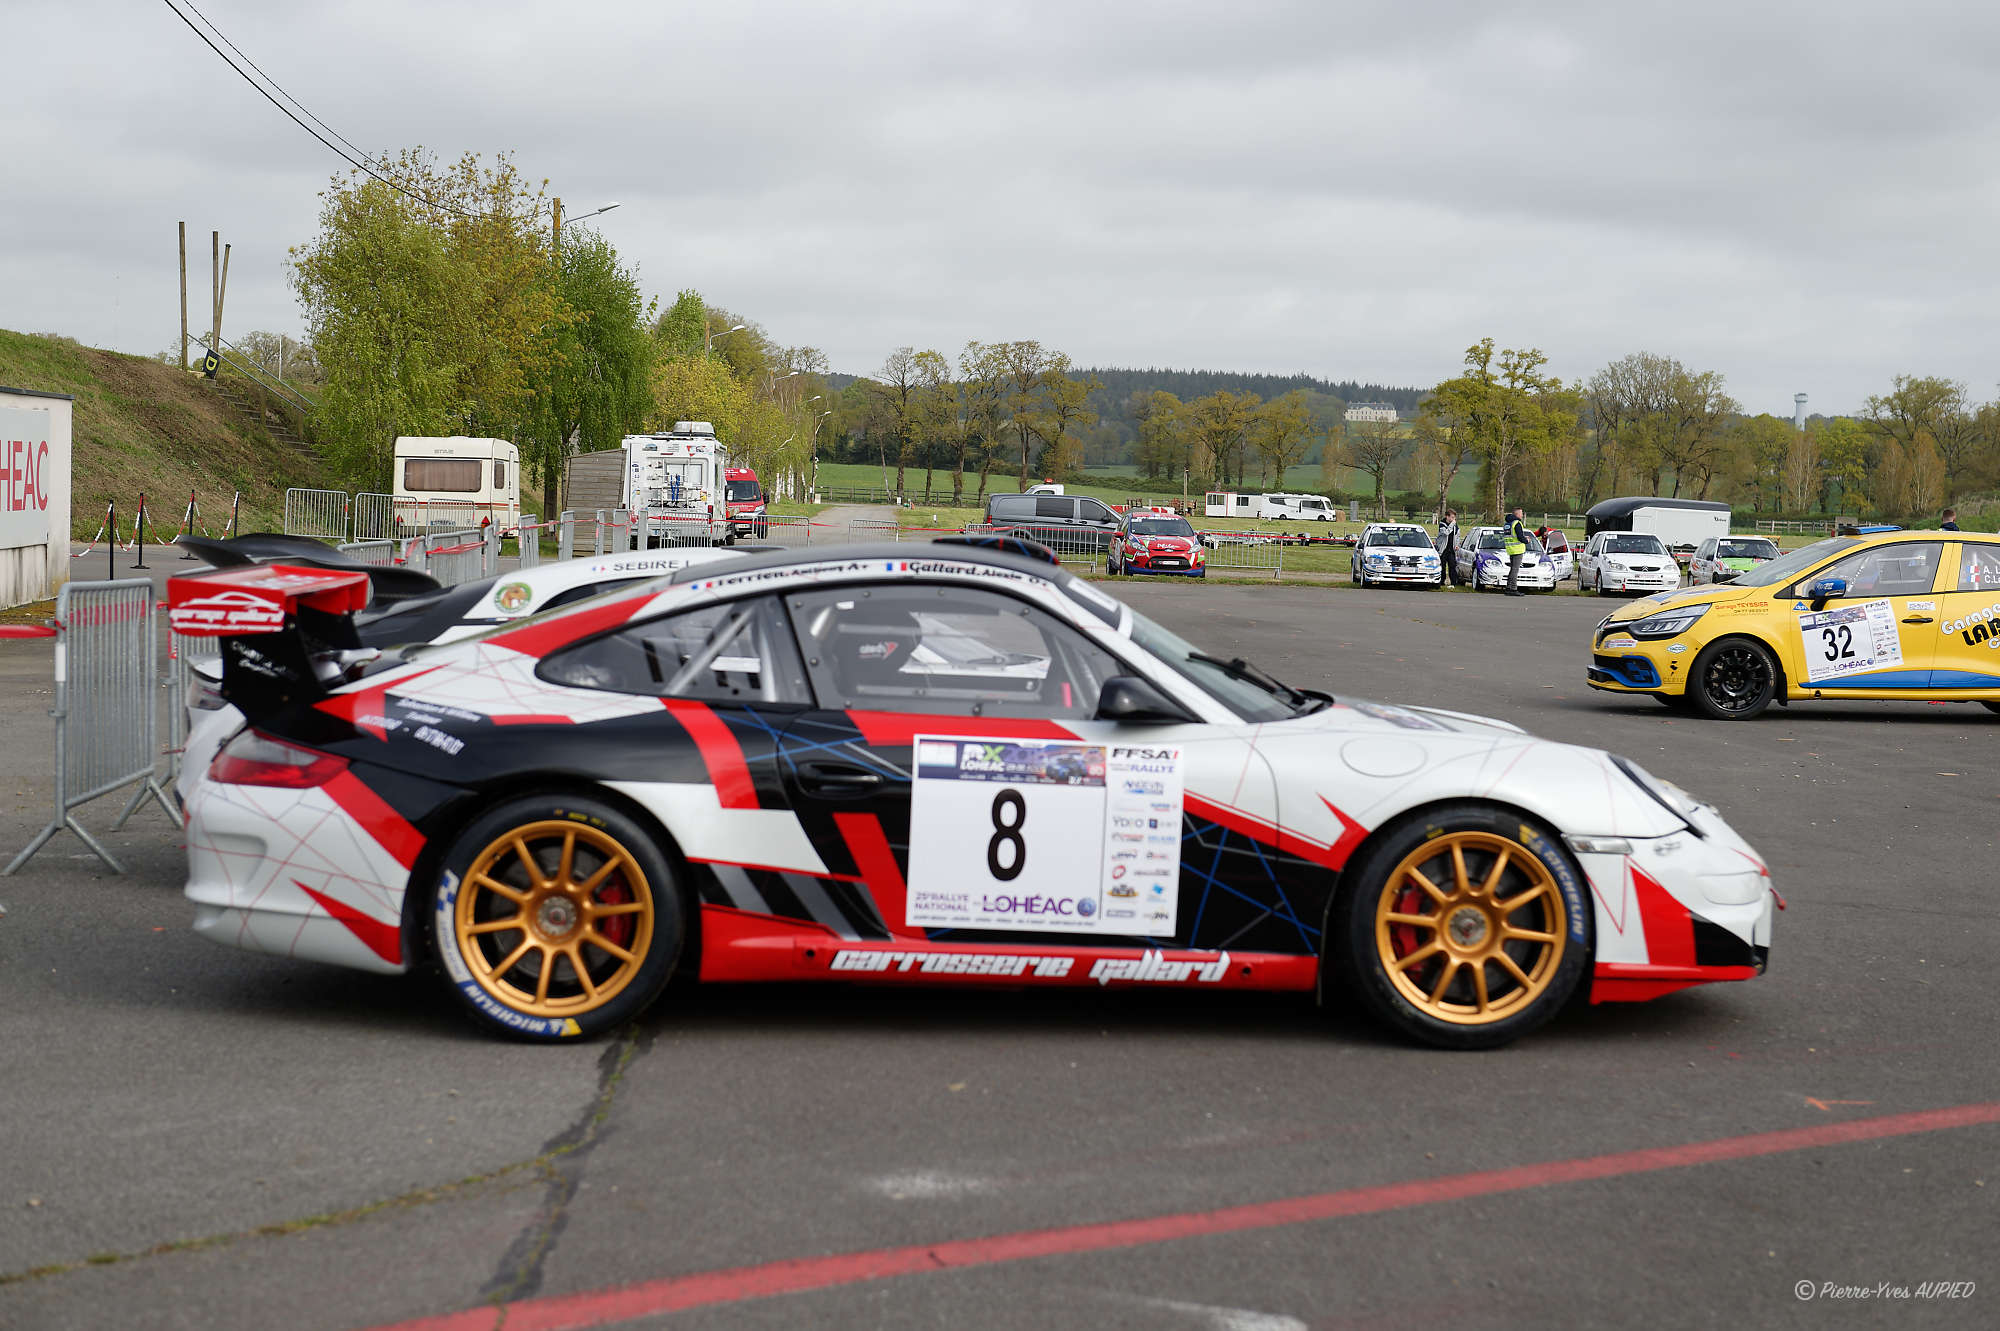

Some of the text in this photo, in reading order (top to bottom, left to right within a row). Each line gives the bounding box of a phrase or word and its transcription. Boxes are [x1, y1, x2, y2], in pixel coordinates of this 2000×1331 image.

[613, 559, 680, 572] SEBIRE
[1822, 625, 1856, 661] 32
[1112, 748, 1170, 760] FFSA
[987, 788, 1027, 882] 8
[914, 902, 969, 912] NATIONAL
[982, 892, 1074, 916] LOHÉAC
[829, 949, 1231, 986] carrosserie gallard
[463, 984, 547, 1033] MICHELIN
